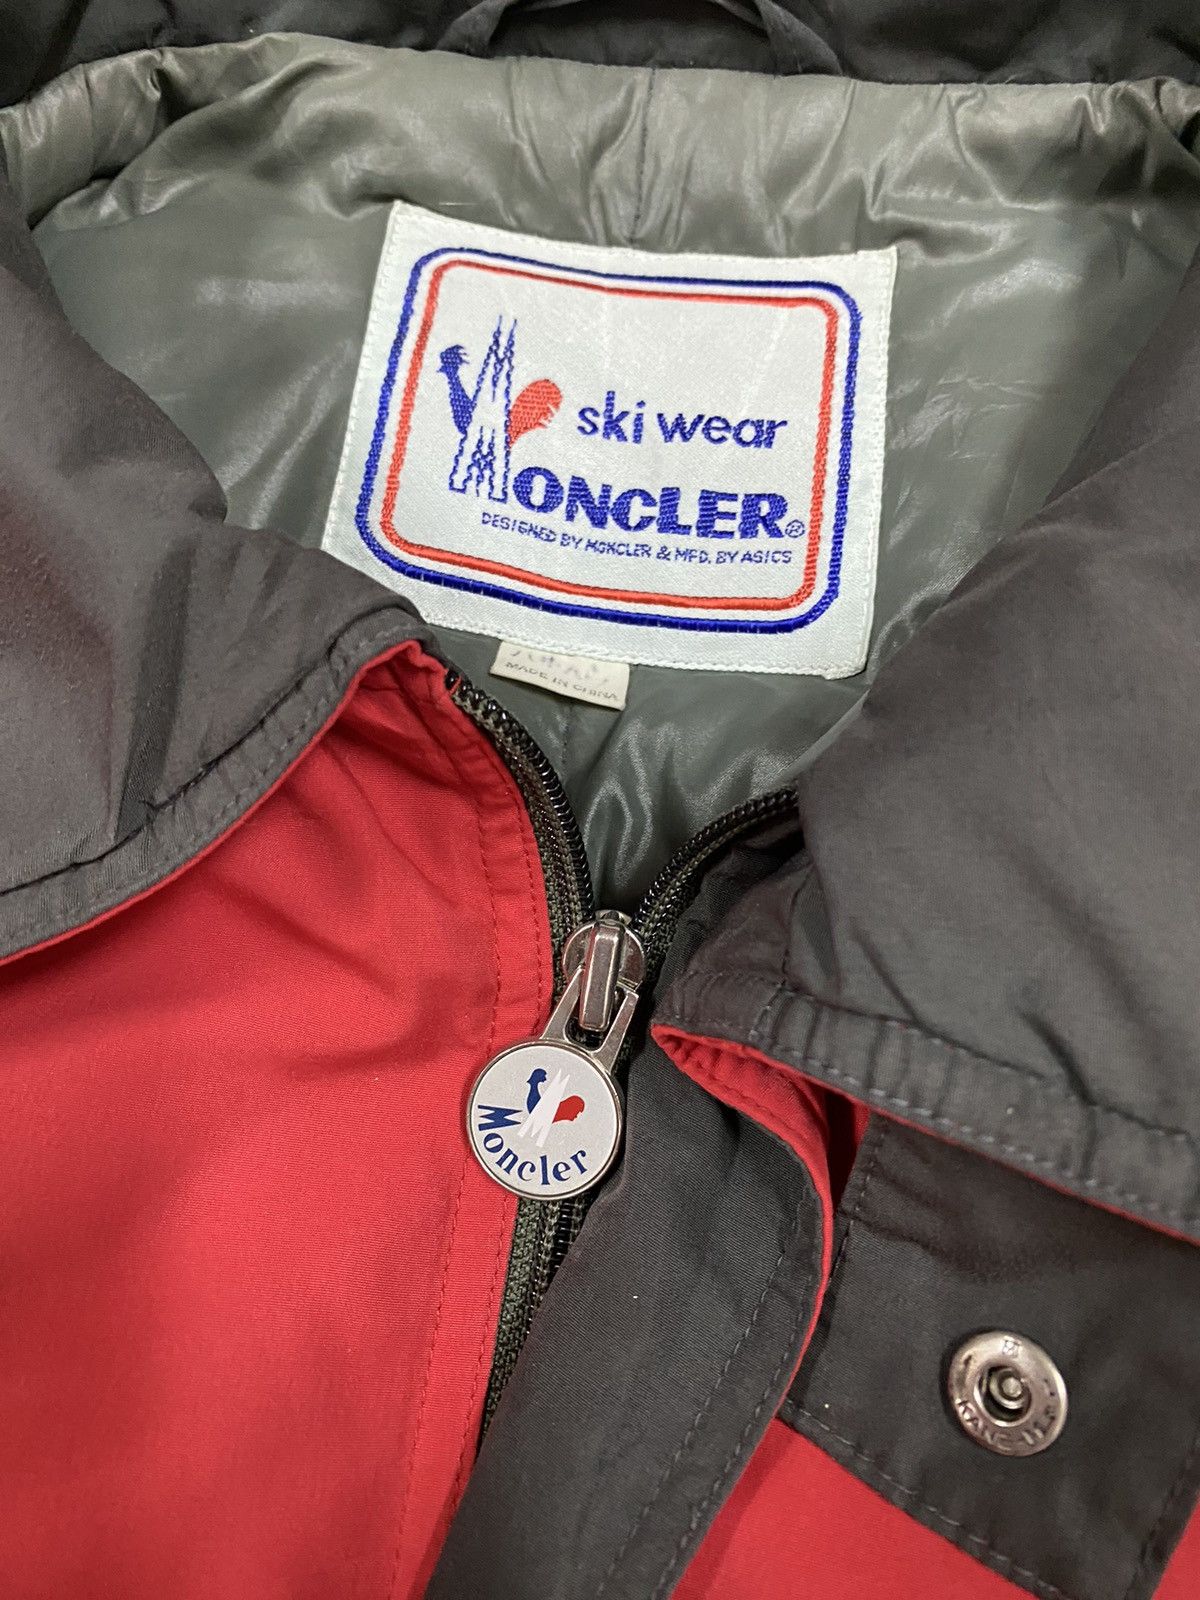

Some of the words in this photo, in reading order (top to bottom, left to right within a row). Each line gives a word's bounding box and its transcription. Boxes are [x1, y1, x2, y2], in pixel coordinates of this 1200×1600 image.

[577, 390, 646, 444] ski
[656, 412, 788, 449] wear
[482, 511, 557, 543] DESIGNED
[560, 533, 583, 549] BY
[656, 545, 671, 561] &
[715, 550, 739, 564] BY
[740, 550, 793, 565] ASICS
[505, 661, 549, 680] MADE
[552, 677, 568, 688] IN
[477, 1104, 587, 1186] Moncler
